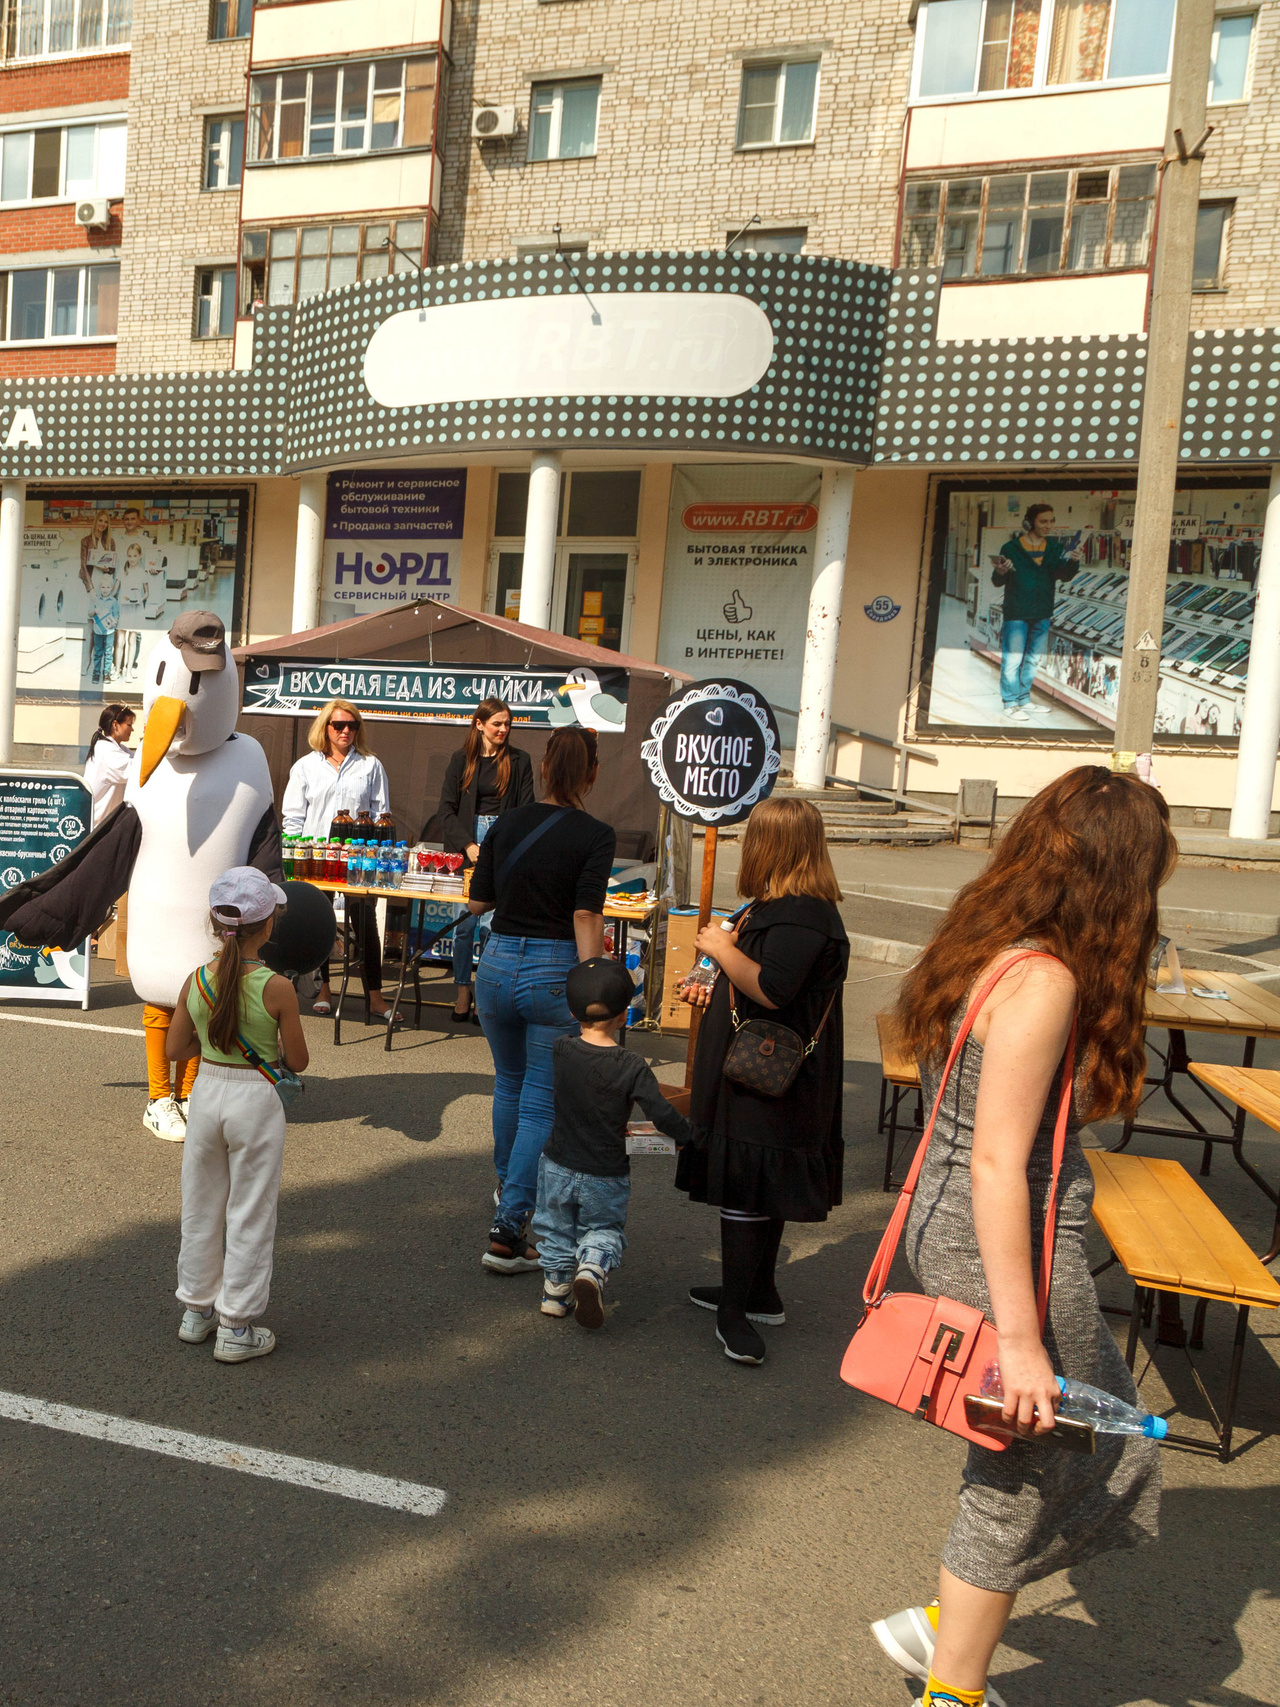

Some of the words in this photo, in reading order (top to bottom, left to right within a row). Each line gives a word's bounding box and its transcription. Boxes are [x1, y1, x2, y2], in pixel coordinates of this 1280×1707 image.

[342, 480, 384, 489] Ремонт
[397, 479, 460, 490] сервисное
[341, 492, 426, 503] обслуживание
[340, 504, 389, 514] бытовой
[392, 505, 440, 514] техники
[692, 509, 804, 527] www.RBT.ru
[339, 521, 391, 532] Продажа
[394, 520, 453, 530] запчастей
[687, 545, 746, 555] БЫТОВАЯ
[750, 545, 808, 555] ТЕХНИКА
[694, 557, 703, 566] И
[707, 557, 798, 566] ЭЛЕКТРОНИКА
[335, 551, 452, 586] НОРД
[334, 590, 407, 600] СЕРВИСНЫЙ
[410, 592, 451, 601] ЦЕНТР
[875, 600, 889, 610] 55
[696, 629, 743, 643] ЦЕНЫ,
[747, 629, 776, 641] КАК
[685, 648, 694, 658] В
[697, 648, 784, 660] ИНТЕРНЕТЕ!
[290, 671, 380, 697] ВКУСНАЯ
[384, 675, 423, 700] ЕДА
[427, 677, 457, 699] ИЗ
[461, 676, 554, 703] «ЧАЙКИ»
[675, 733, 754, 767] ВКУСНОЕ
[683, 766, 740, 798] МЕСТО
[64, 820, 76, 831] 250
[56, 848, 65, 861] 50
[7, 870, 17, 882] 80
